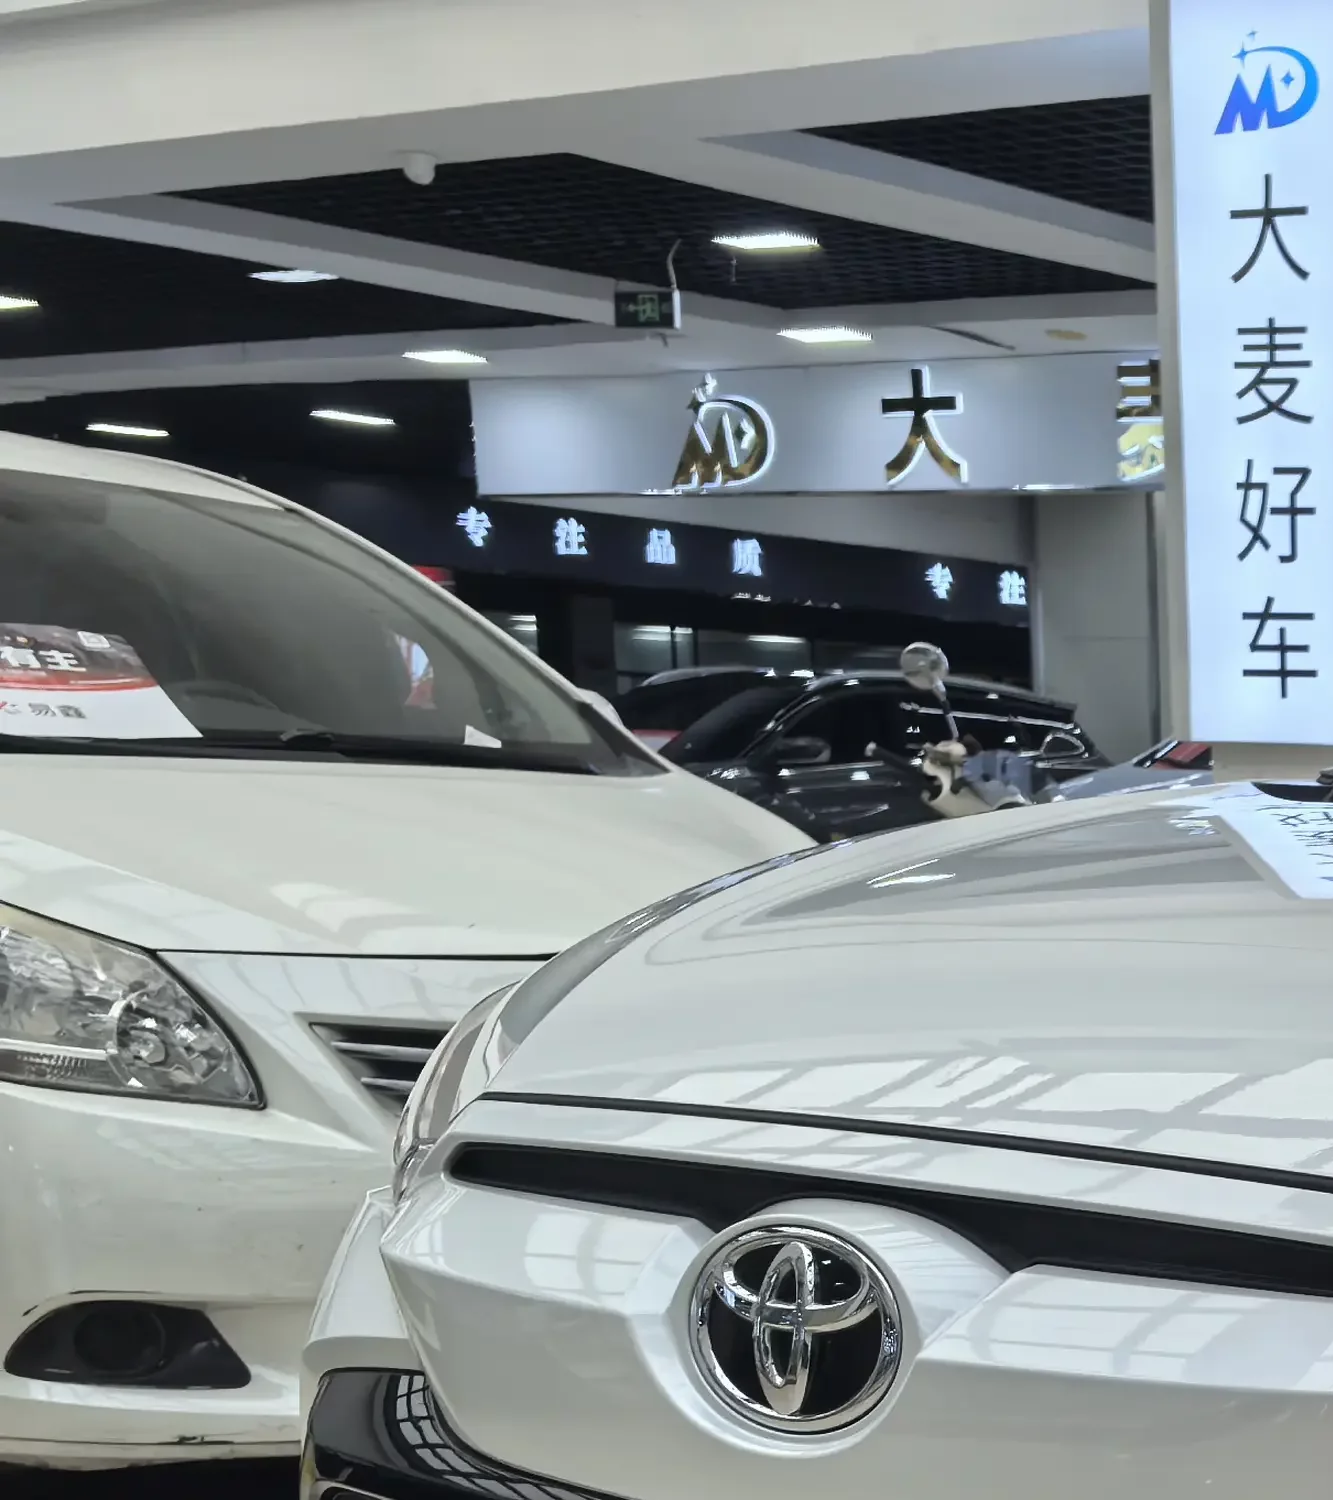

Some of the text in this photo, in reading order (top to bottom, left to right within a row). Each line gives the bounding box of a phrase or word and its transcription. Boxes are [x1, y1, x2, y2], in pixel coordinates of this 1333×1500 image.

[454, 505, 764, 577] 专注品质
[1230, 173, 1318, 699] 大麦好车
